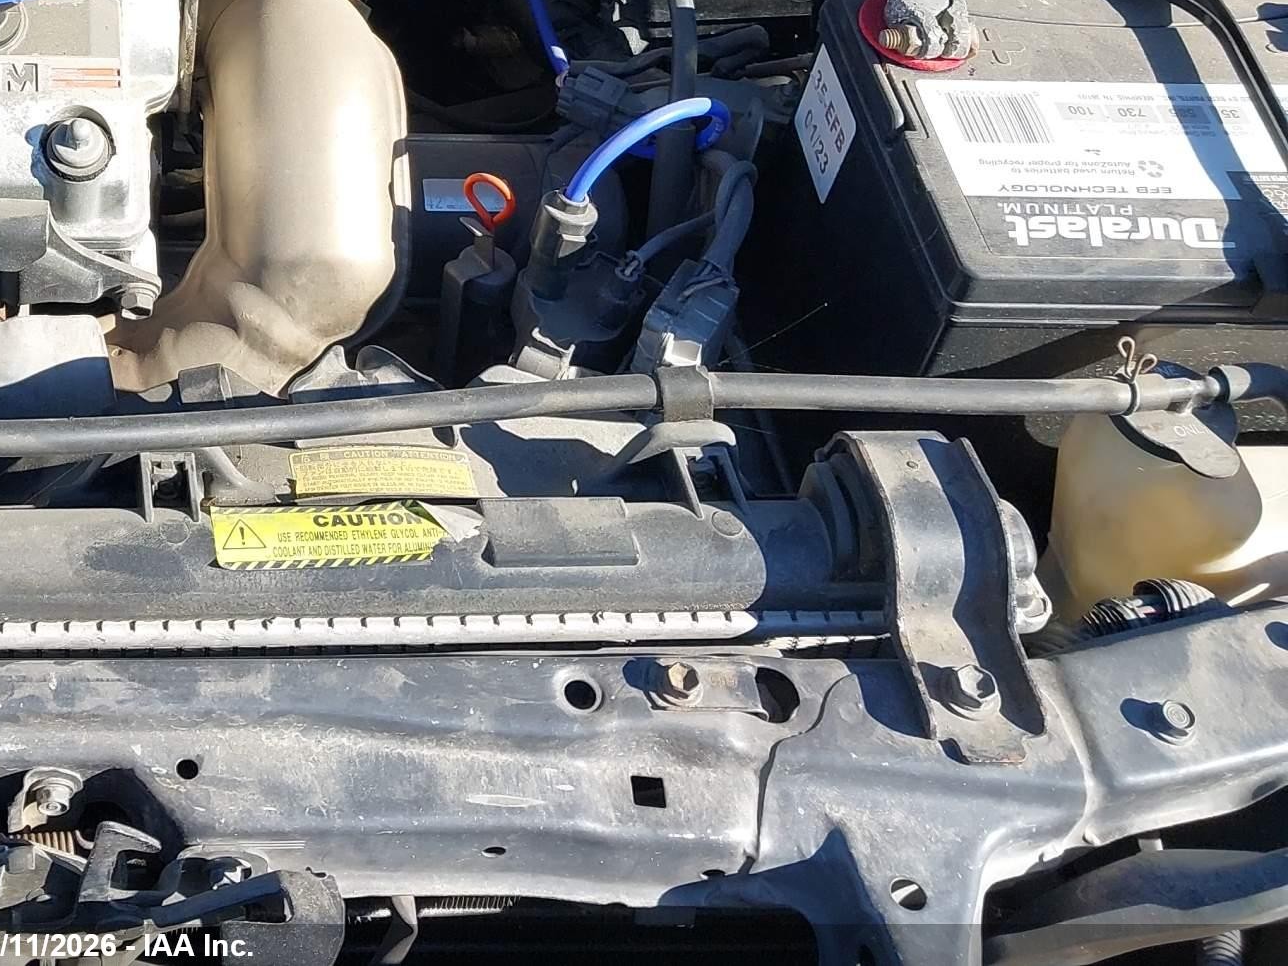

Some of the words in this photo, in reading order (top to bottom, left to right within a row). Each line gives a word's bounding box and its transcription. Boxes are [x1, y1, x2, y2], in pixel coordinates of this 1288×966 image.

[813, 68, 846, 154] 35-EFB
[1067, 104, 1095, 116] 100
[1116, 106, 1148, 118] 730
[804, 109, 829, 174] 01/23
[978, 158, 1026, 167] recycling
[1064, 160, 1079, 168] for
[1081, 160, 1132, 168] AutoZone
[1011, 167, 1022, 175] to
[1024, 167, 1071, 176] batteries
[1072, 168, 1098, 176] used
[1100, 168, 1135, 176] Return
[998, 184, 1128, 194] TECHNOLOGY
[1136, 186, 1172, 194] EFB
[1008, 214, 1236, 249] Duralast
[343, 450, 389, 459] CAUTION
[312, 512, 423, 528] CAUTION
[277, 532, 293, 543] USE
[295, 530, 348, 542] RECOMMENDED
[352, 529, 388, 541] ETHYLENE
[391, 528, 420, 539] GLYCOL
[273, 545, 306, 558] COOLANT
[308, 545, 323, 556] AND
[324, 544, 361, 556] DISTILLED
[361, 543, 387, 554] WATER
[388, 542, 402, 554] FOR
